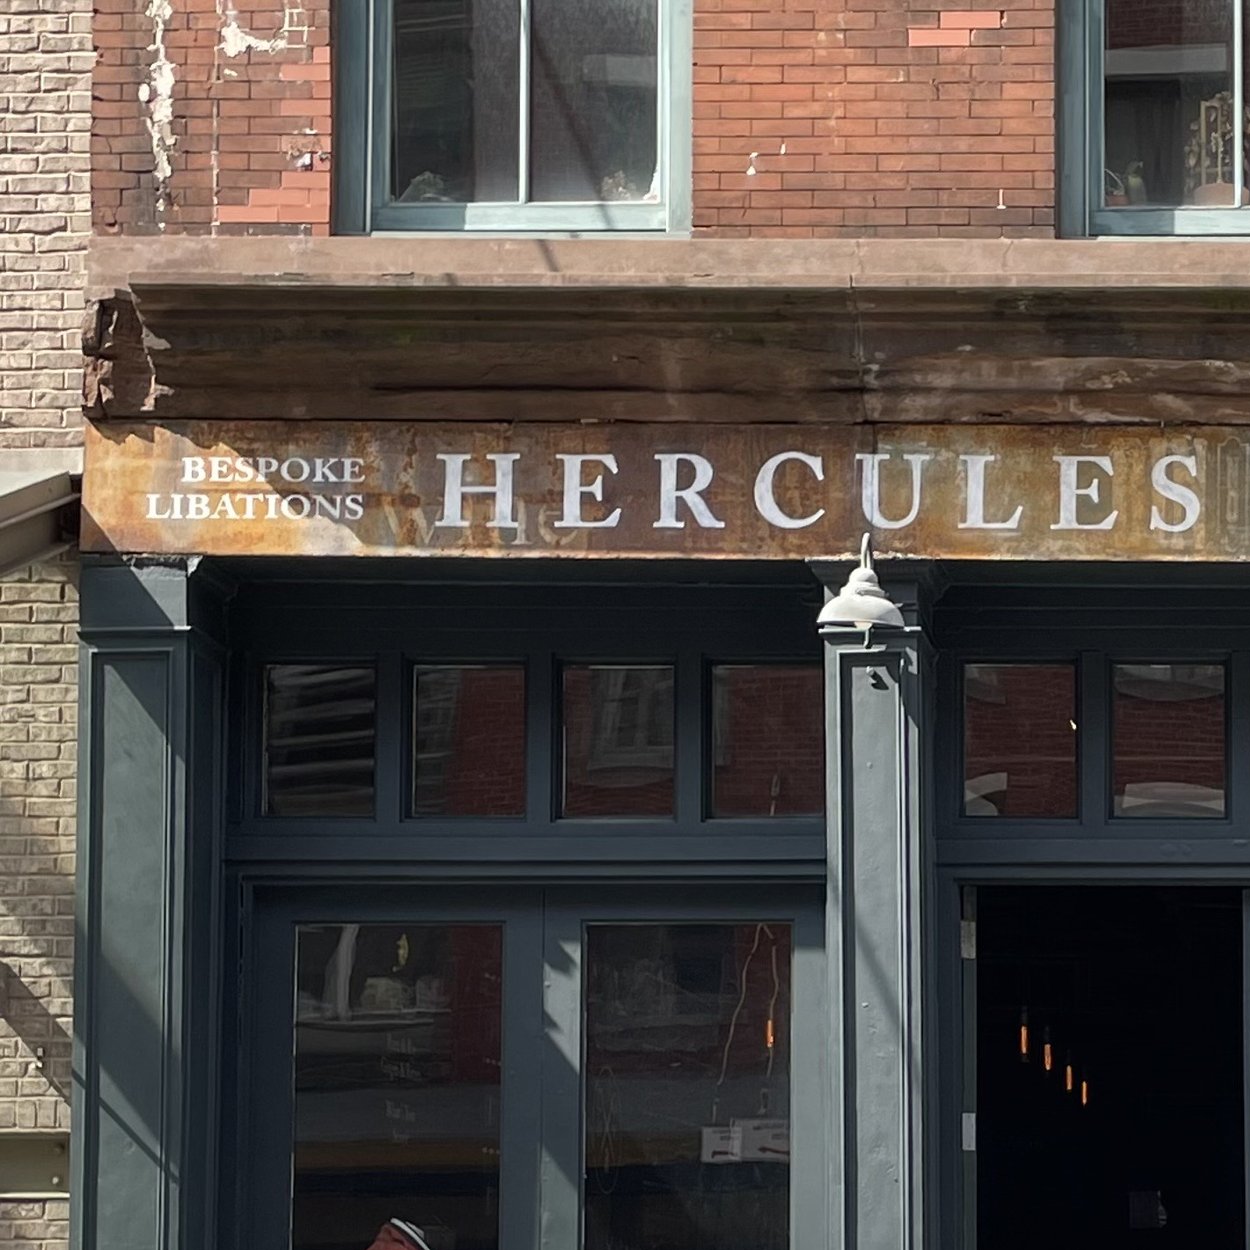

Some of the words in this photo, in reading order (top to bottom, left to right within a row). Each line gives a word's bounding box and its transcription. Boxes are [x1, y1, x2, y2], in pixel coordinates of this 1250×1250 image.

[180, 456, 366, 484] BESPOKE
[434, 450, 1202, 533] HERCULES
[145, 492, 365, 521] LIBATIONS
